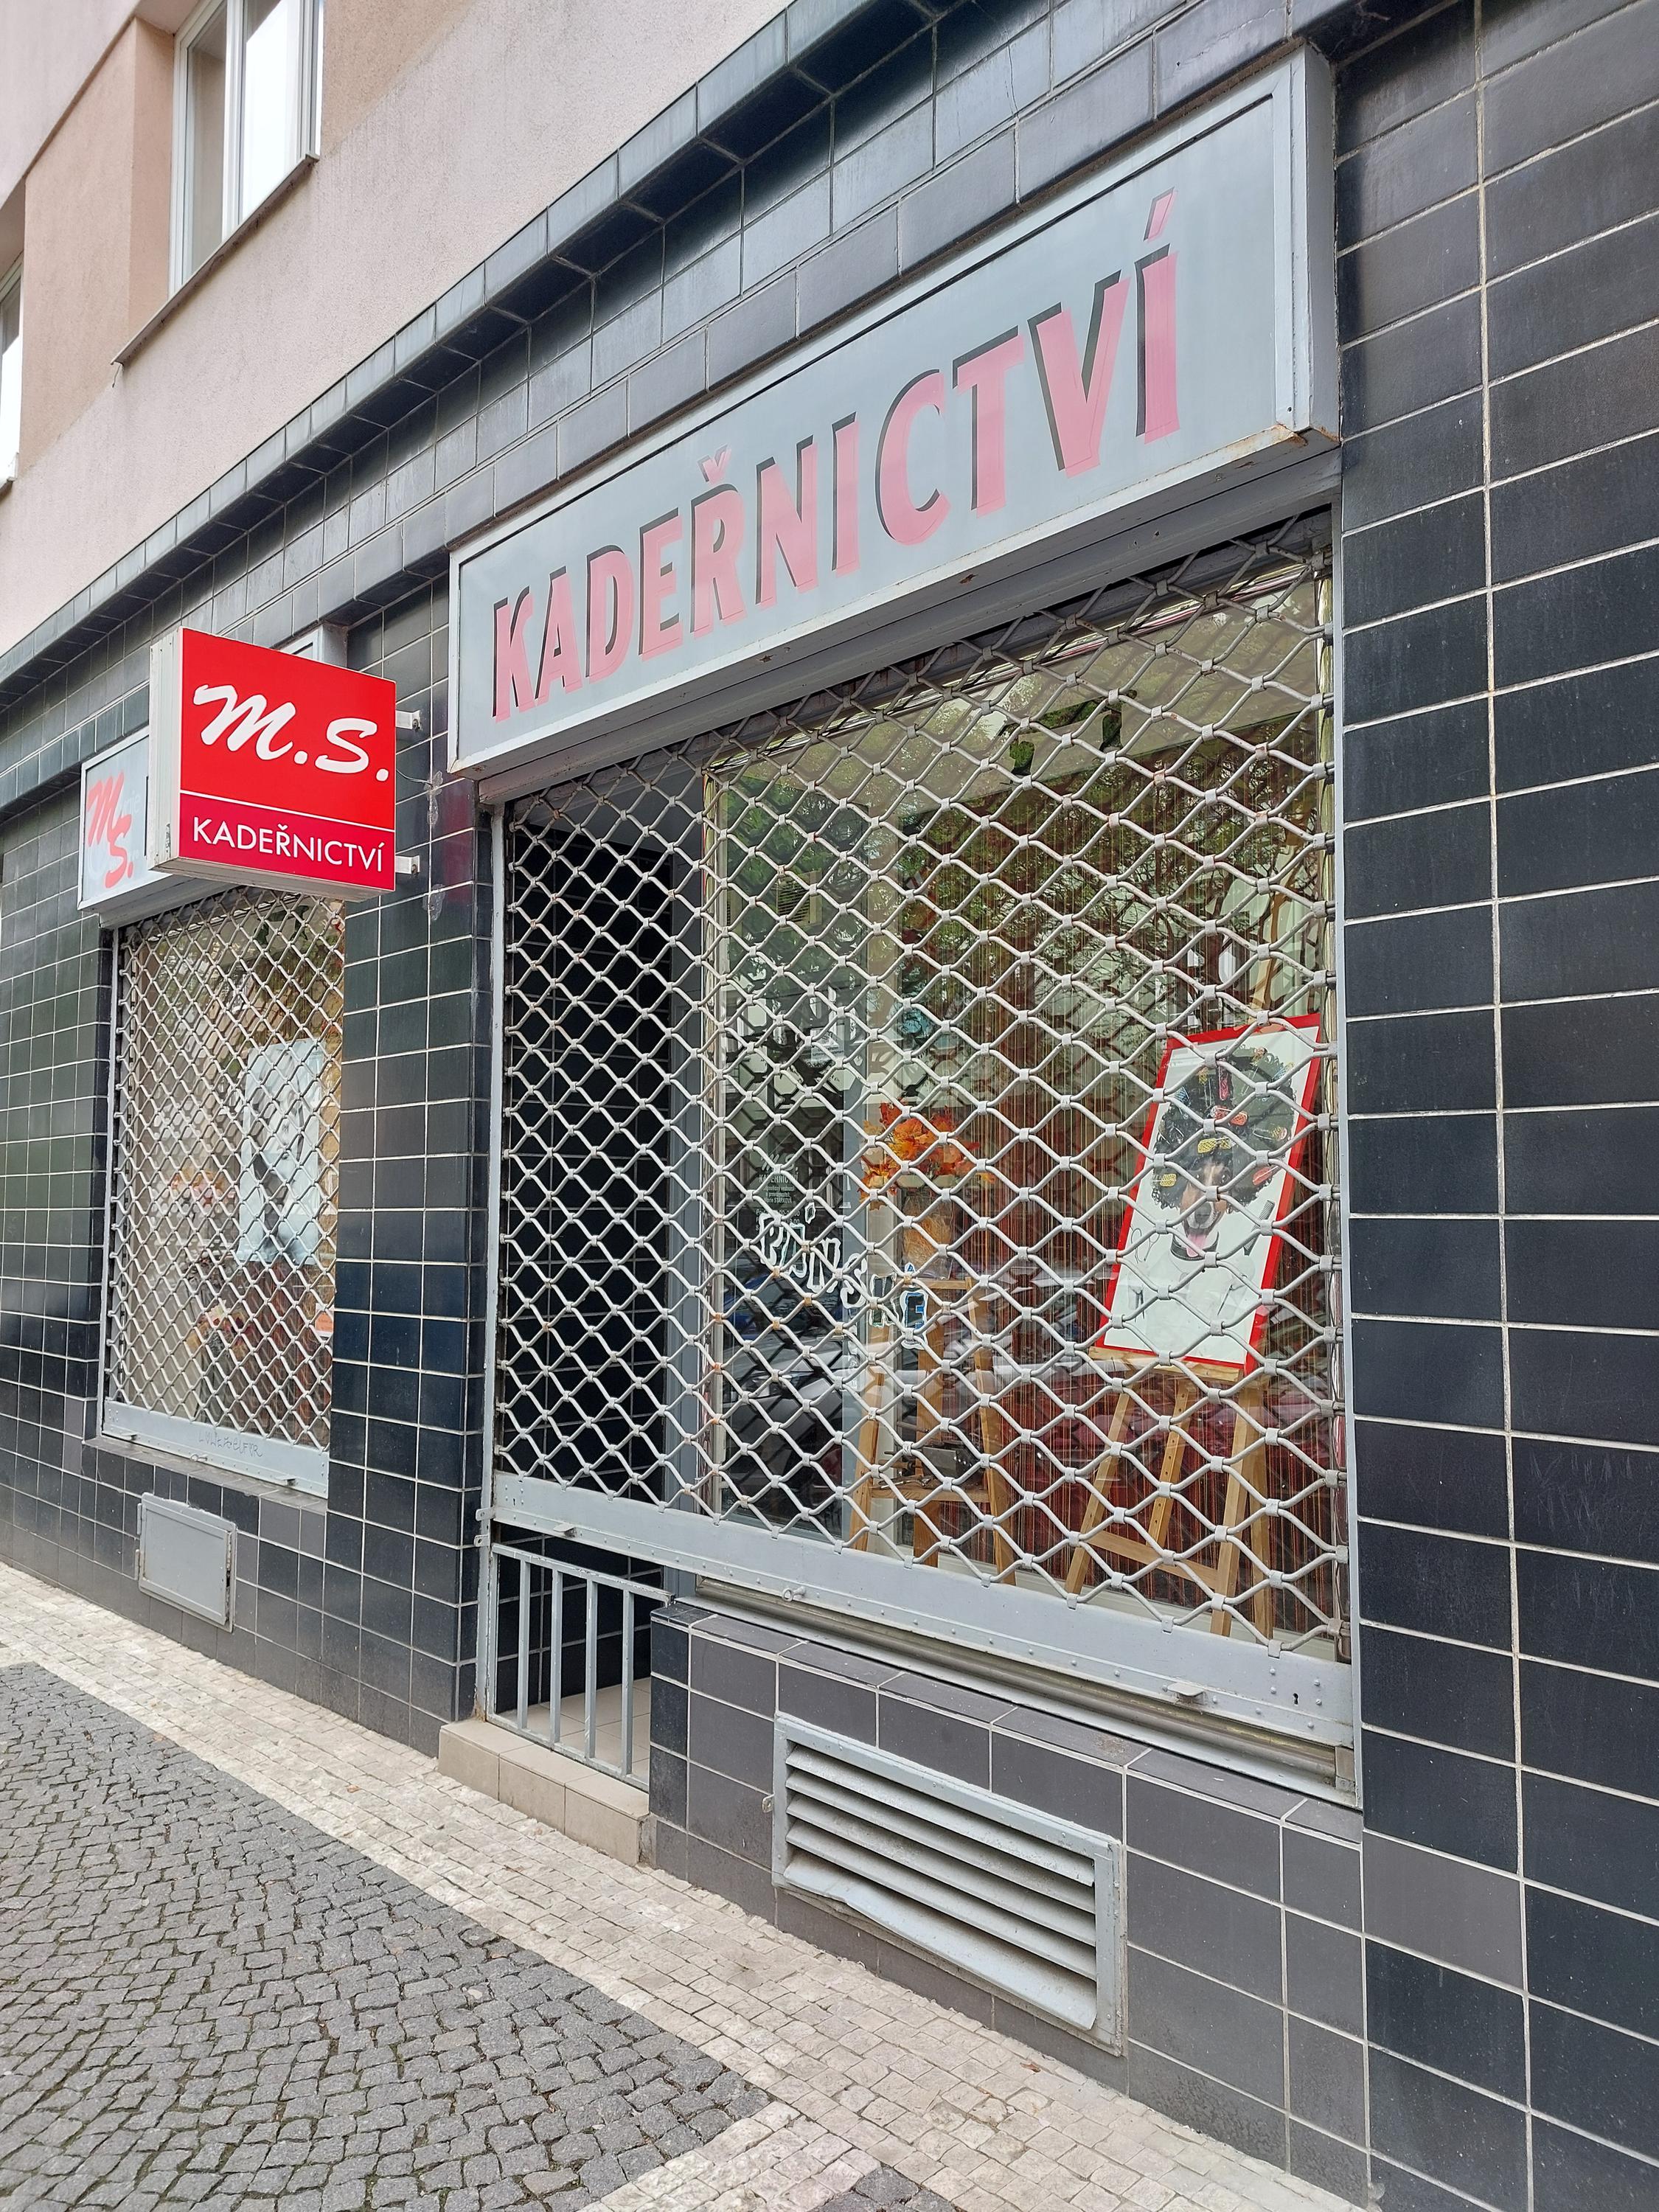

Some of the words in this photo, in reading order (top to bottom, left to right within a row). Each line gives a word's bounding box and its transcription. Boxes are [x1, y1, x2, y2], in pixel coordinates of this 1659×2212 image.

[492, 187, 1180, 723] KADEŘNICTVÍ
[194, 684, 389, 781] M.S.
[194, 816, 384, 872] KADEŘNICTVÍ
